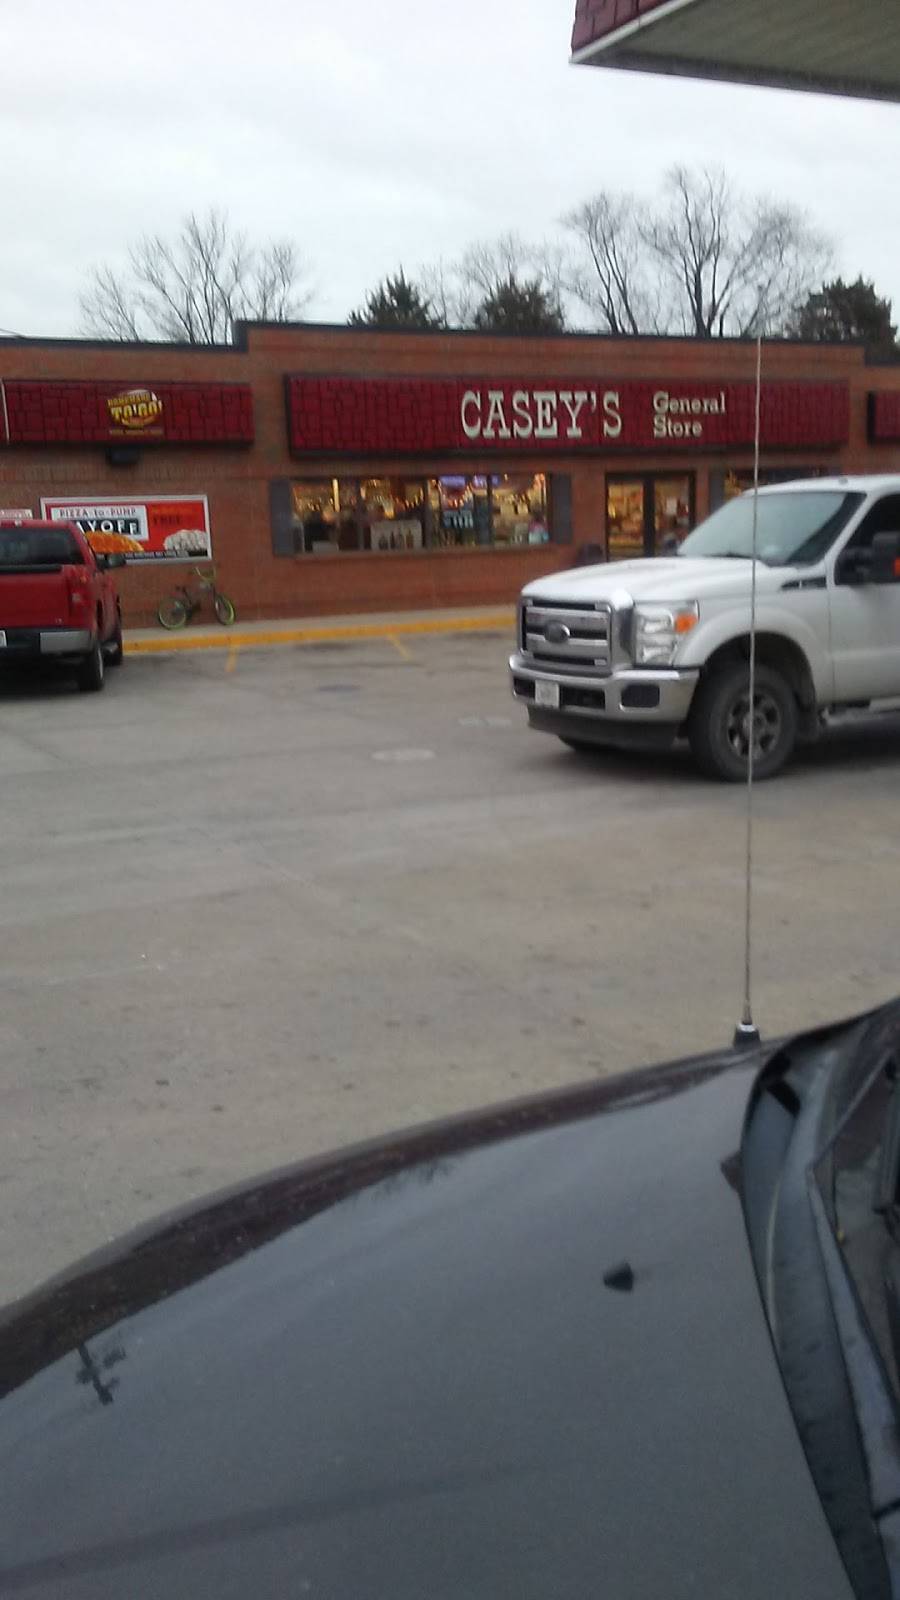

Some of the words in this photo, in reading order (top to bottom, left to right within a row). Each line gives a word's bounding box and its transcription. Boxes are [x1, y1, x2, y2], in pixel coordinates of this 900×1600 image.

[461, 390, 622, 439] CASEY'S
[652, 391, 726, 415] General
[652, 415, 703, 438] Store
[60, 508, 89, 517] PIZZA
